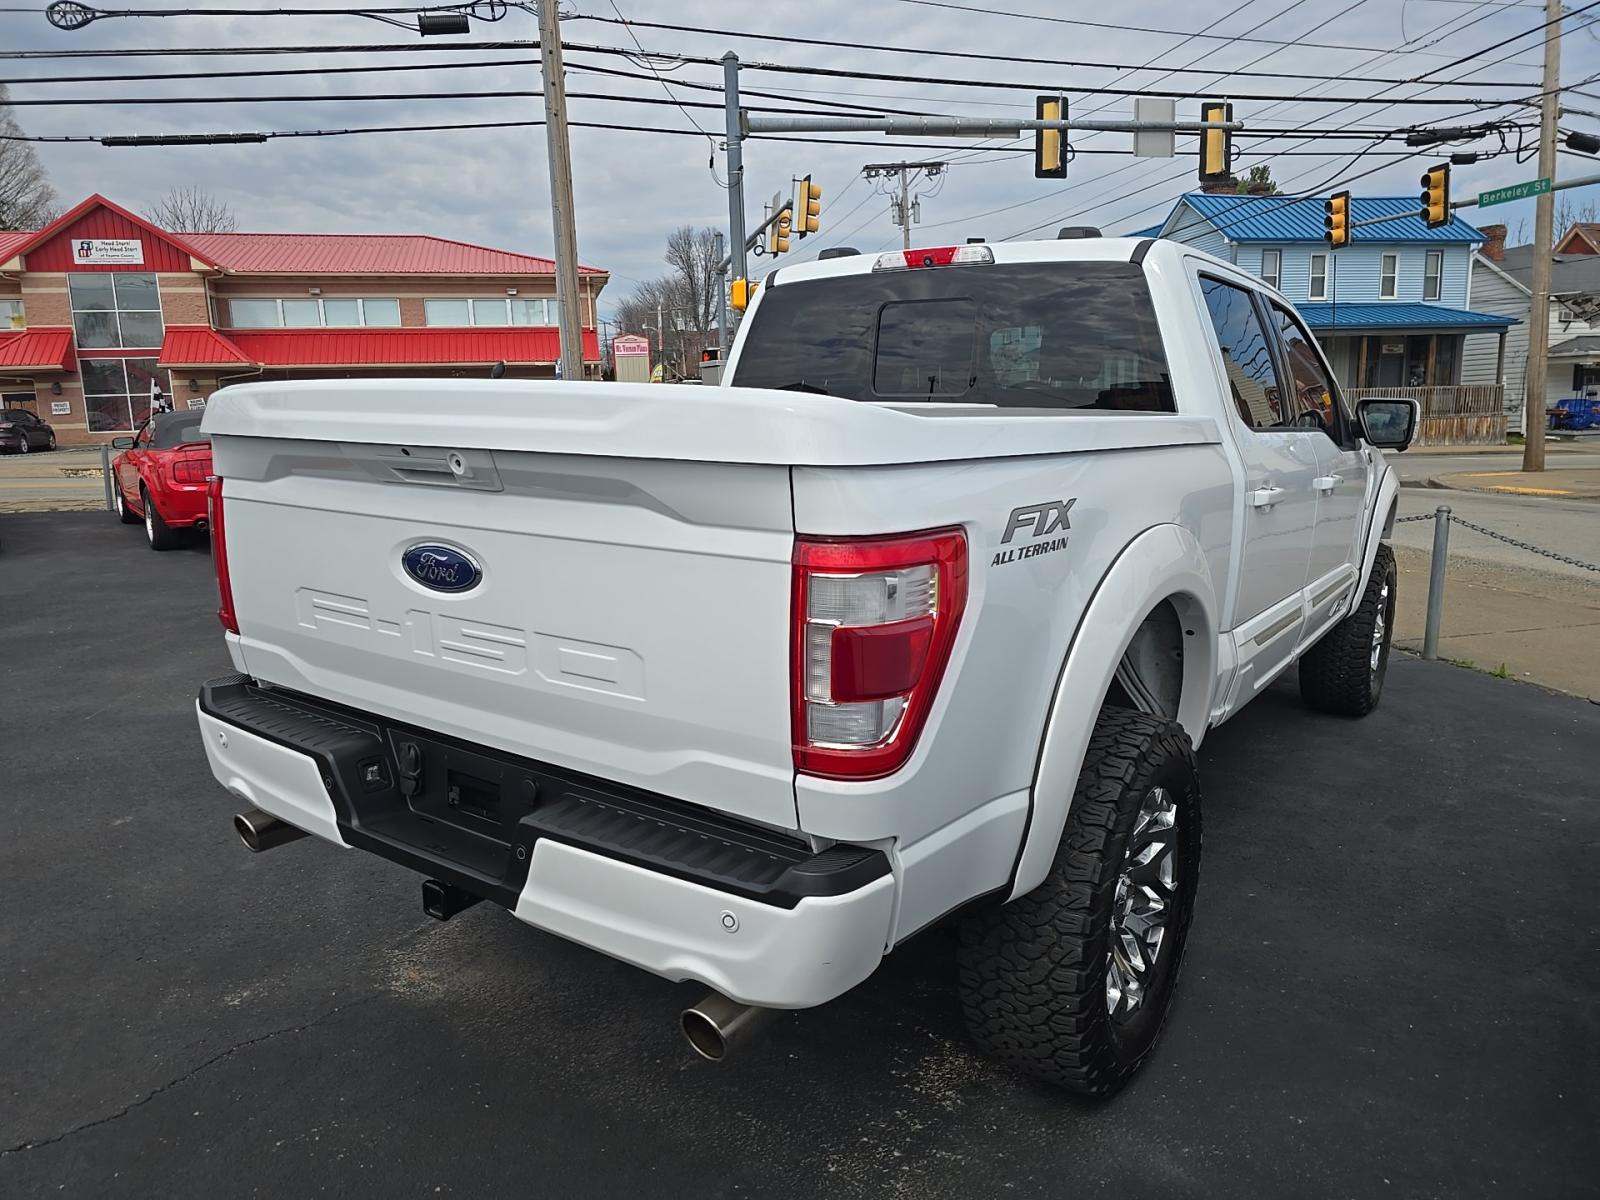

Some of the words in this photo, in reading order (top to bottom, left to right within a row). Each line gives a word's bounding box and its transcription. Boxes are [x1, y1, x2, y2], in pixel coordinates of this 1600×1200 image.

[1482, 185, 1529, 204] Berkeley
[1534, 181, 1546, 192] St
[1000, 497, 1077, 544] FTX
[416, 551, 460, 582] Ford
[990, 550, 1016, 567] ALL
[1017, 537, 1069, 561] TERRAIN
[294, 586, 648, 702] F-150
